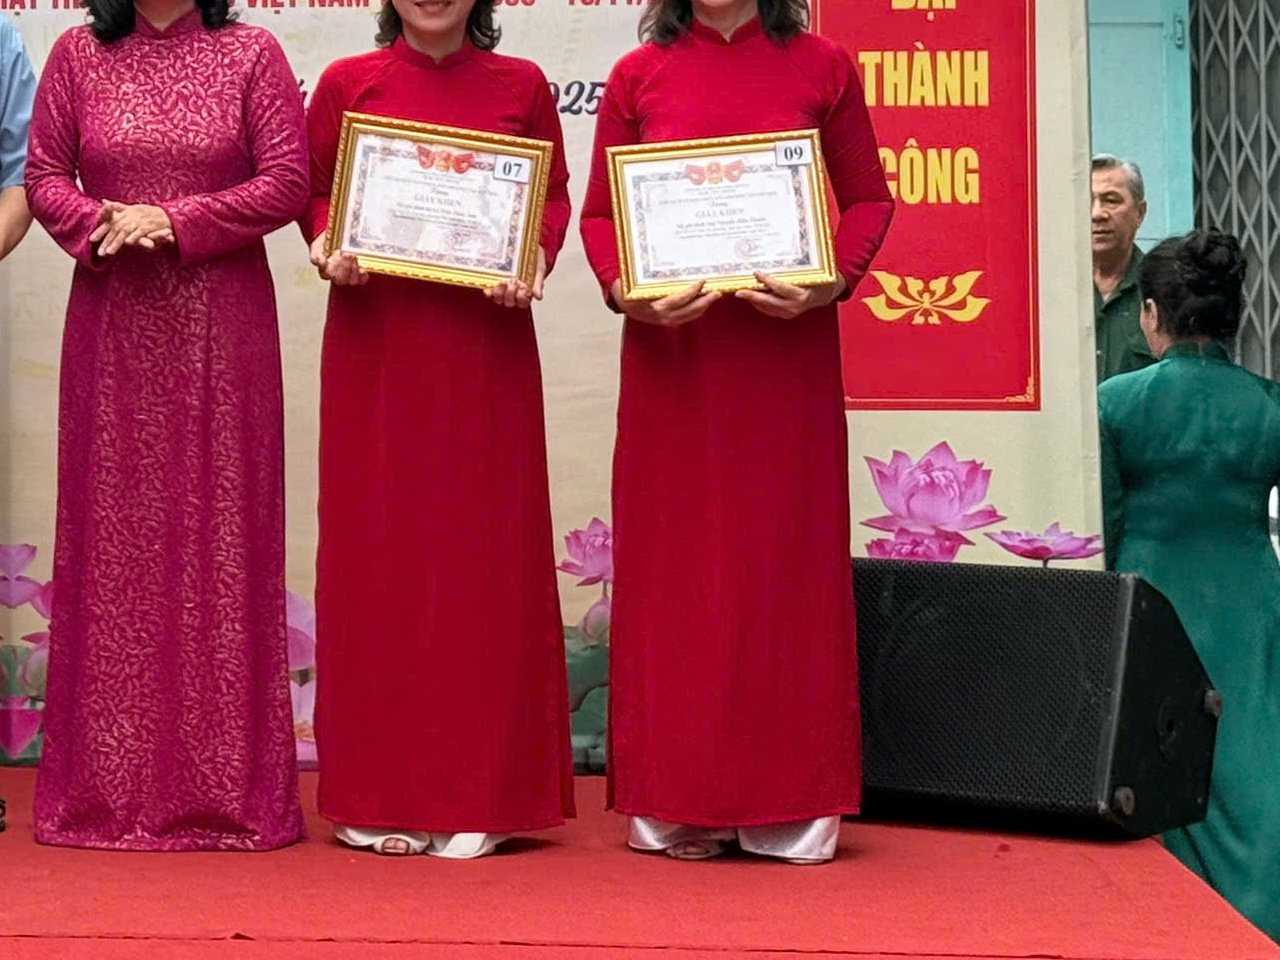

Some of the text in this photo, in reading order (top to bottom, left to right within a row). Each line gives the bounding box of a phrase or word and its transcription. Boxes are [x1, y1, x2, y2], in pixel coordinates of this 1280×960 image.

[858, 41, 990, 107] THÀNH
[502, 161, 523, 177] 07
[783, 145, 804, 161] 09
[878, 137, 981, 205] CÔNG
